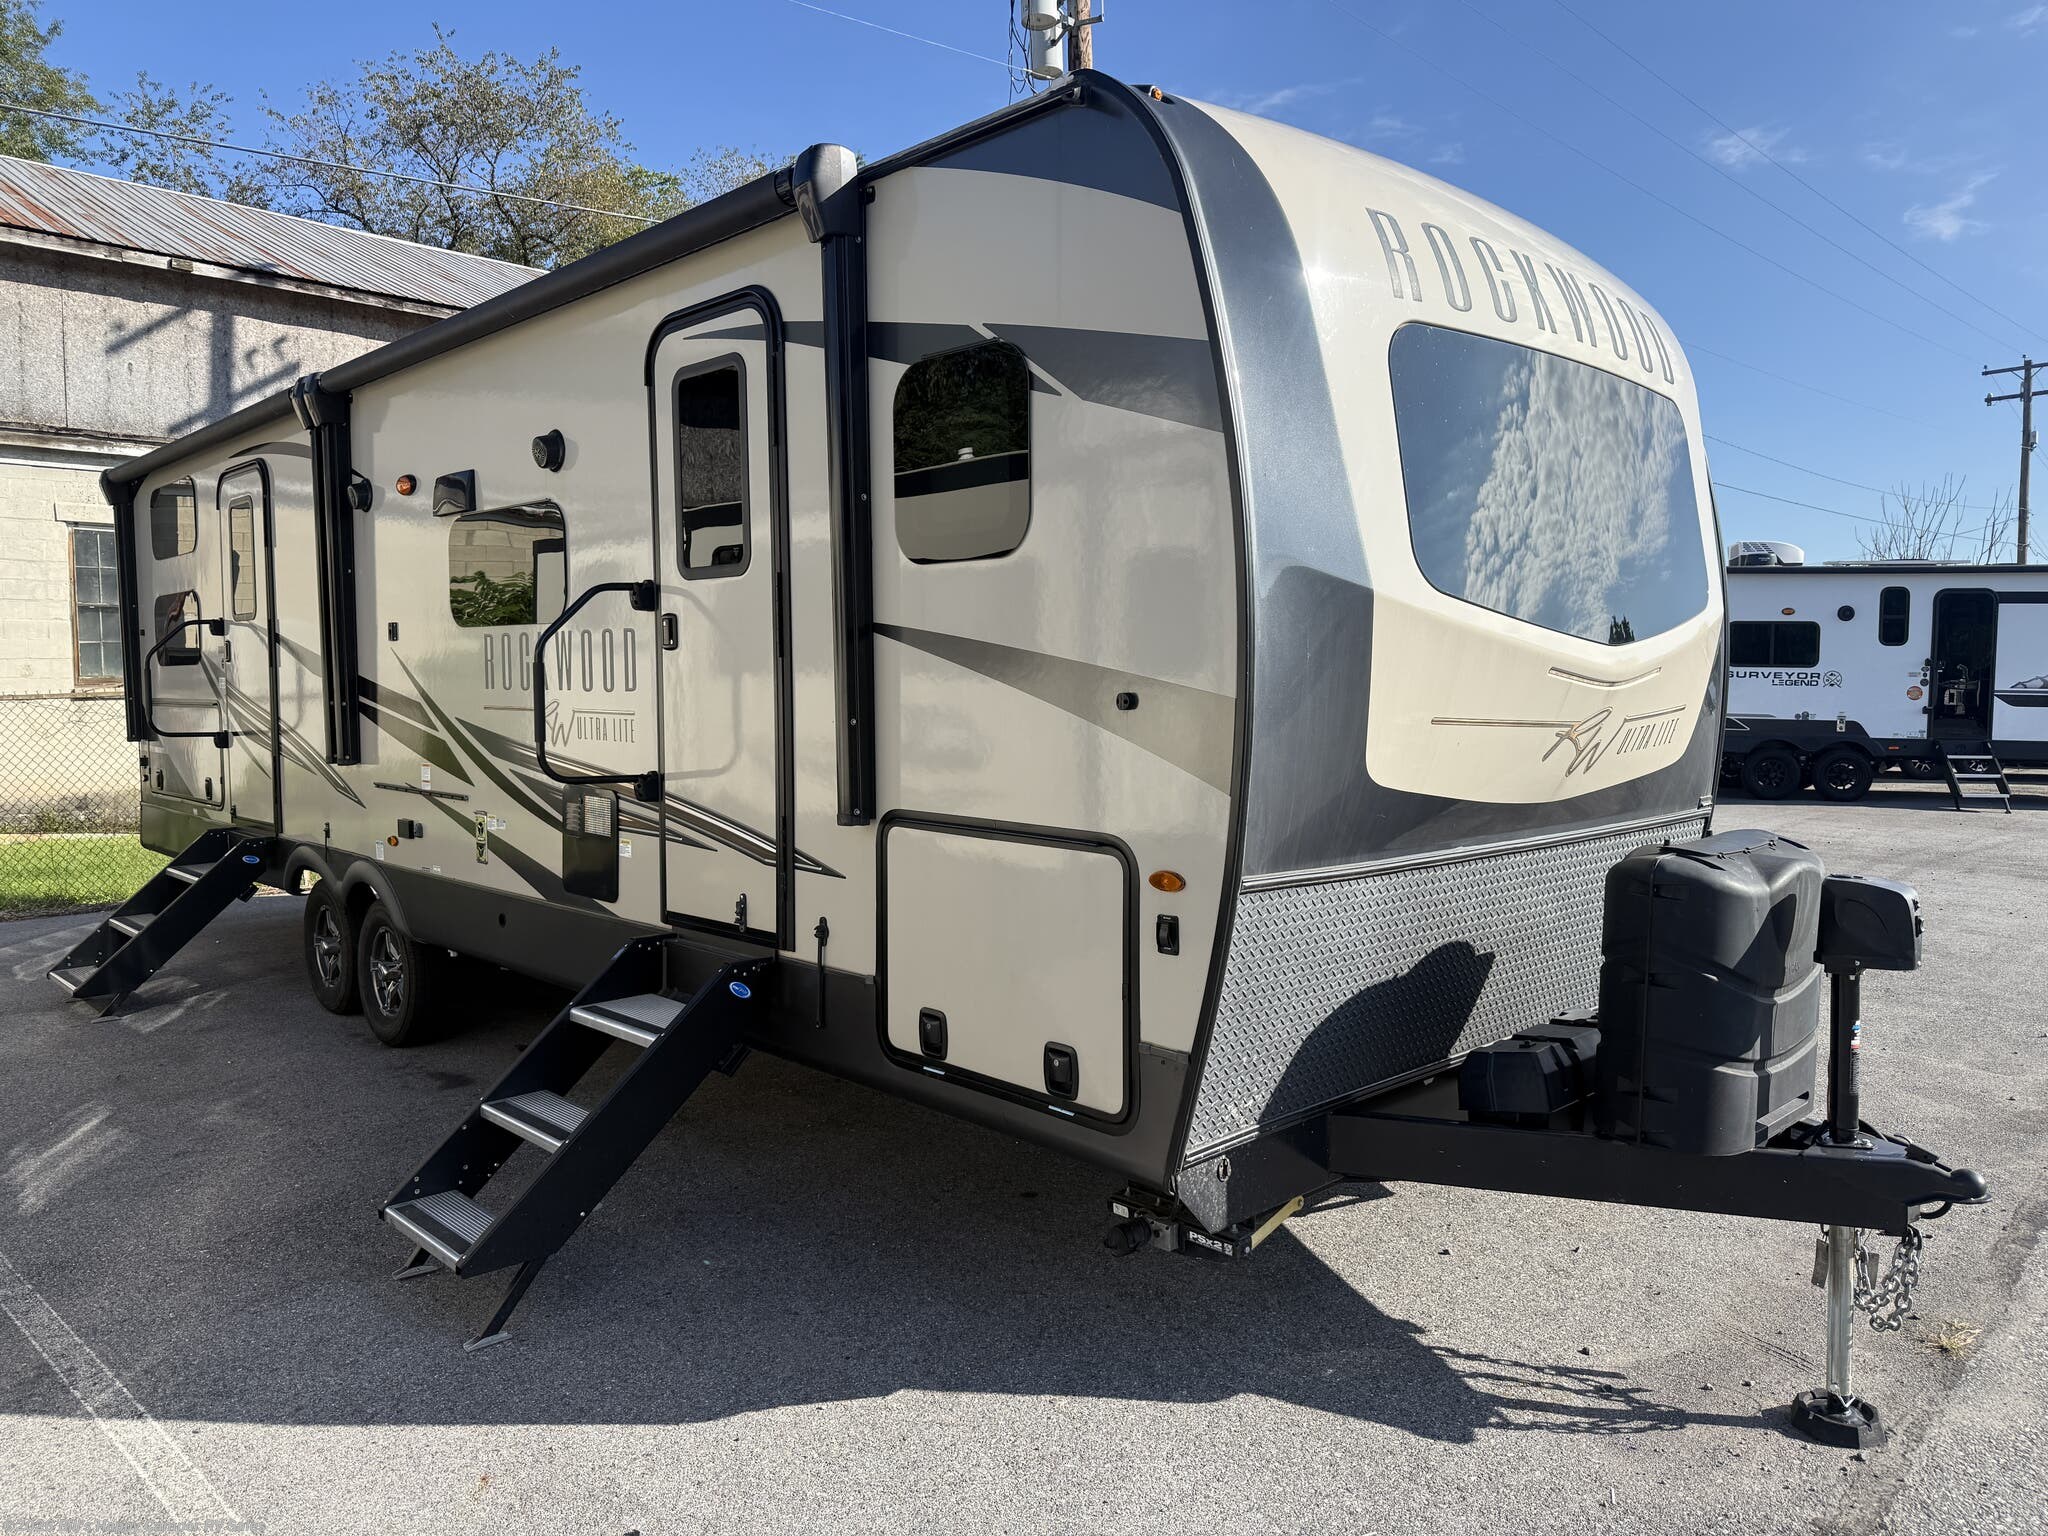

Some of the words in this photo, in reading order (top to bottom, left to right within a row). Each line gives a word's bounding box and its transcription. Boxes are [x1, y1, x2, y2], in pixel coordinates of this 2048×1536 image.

[1365, 206, 1675, 385] ROCKWOOD
[483, 627, 638, 693] ROCWOOD
[1729, 671, 1821, 680] SURVEYOR
[1771, 679, 1819, 687] LEGEND
[576, 716, 608, 742] ULTRA
[612, 717, 636, 744] LITE
[1616, 723, 1656, 755] ULTRA
